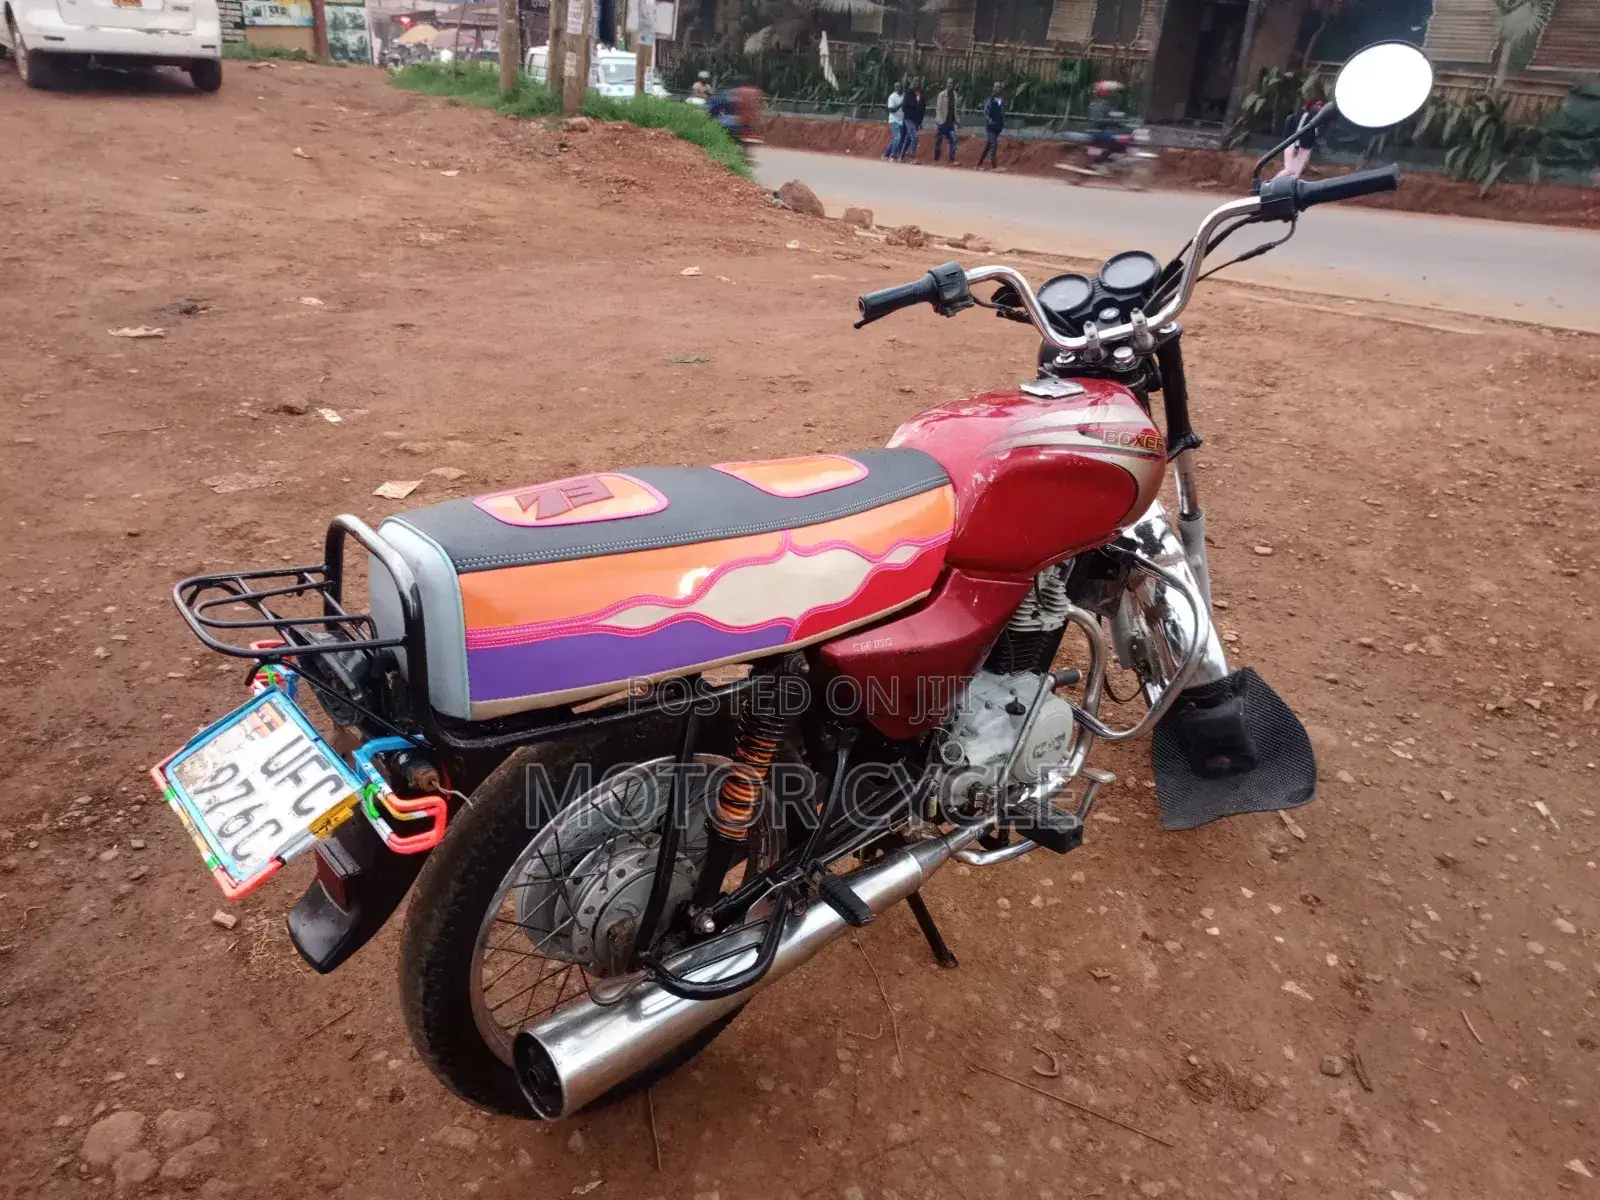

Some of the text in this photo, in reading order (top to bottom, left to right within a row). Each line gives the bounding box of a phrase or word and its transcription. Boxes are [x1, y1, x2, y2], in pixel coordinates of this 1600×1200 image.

[1103, 431, 1164, 450] BOXER
[194, 763, 283, 862] 976C
[260, 735, 344, 817] UFC
